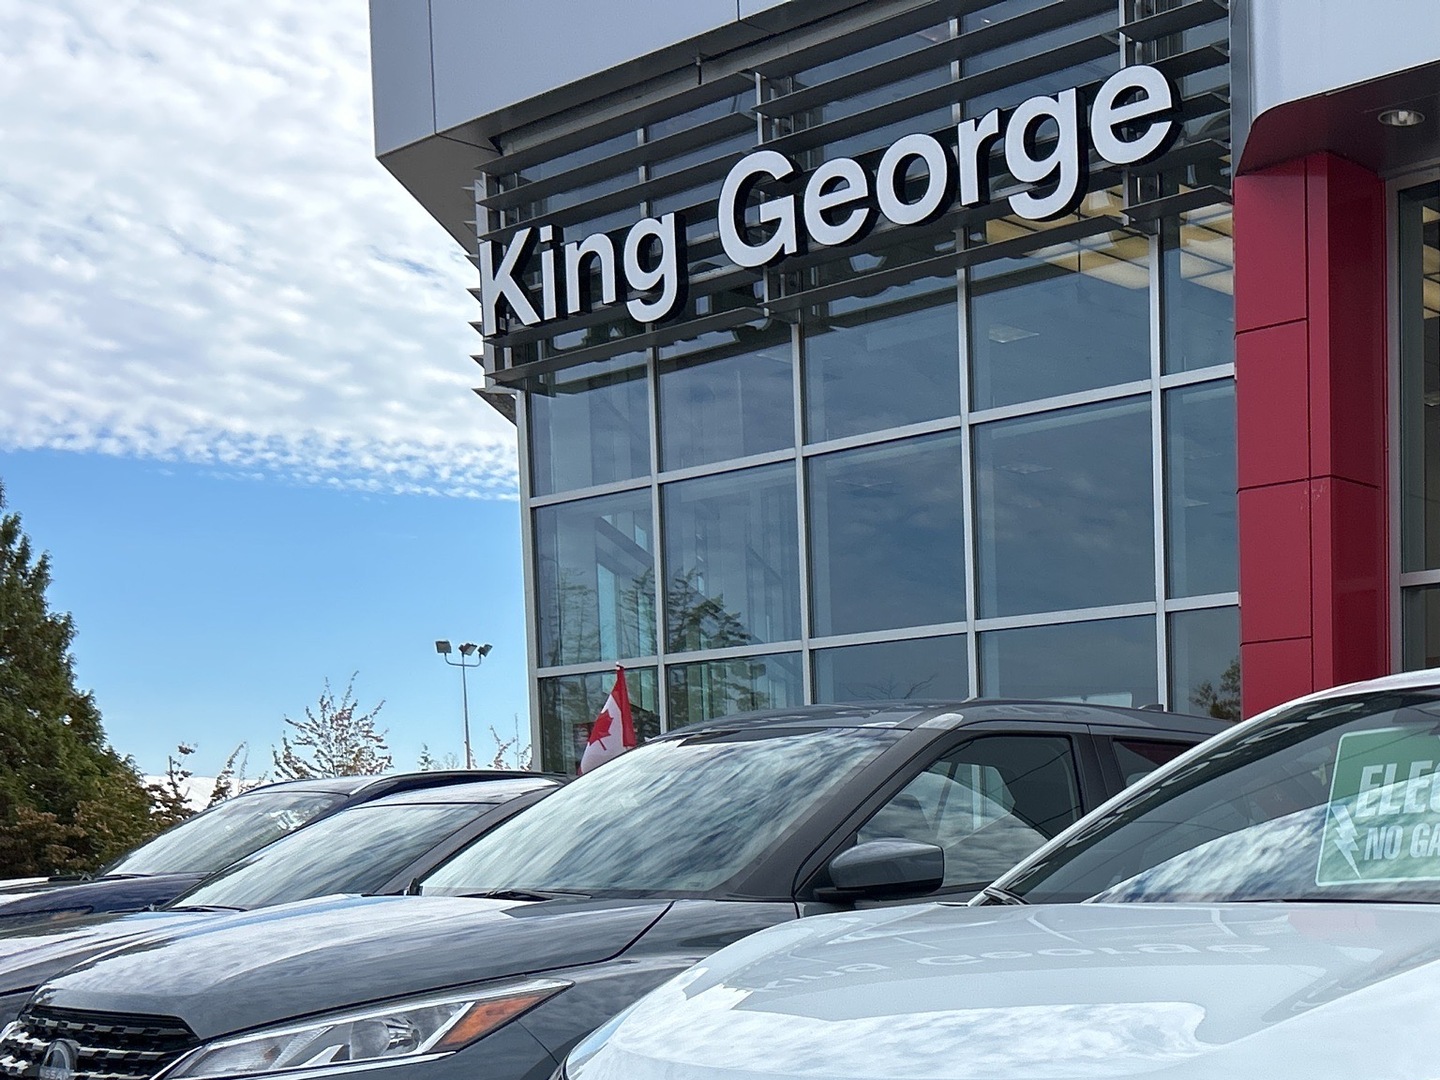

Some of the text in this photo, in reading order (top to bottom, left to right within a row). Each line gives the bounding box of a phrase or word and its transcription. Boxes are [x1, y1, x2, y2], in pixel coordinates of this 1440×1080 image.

[480, 64, 1173, 337] King George
[1364, 825, 1404, 861] NO
